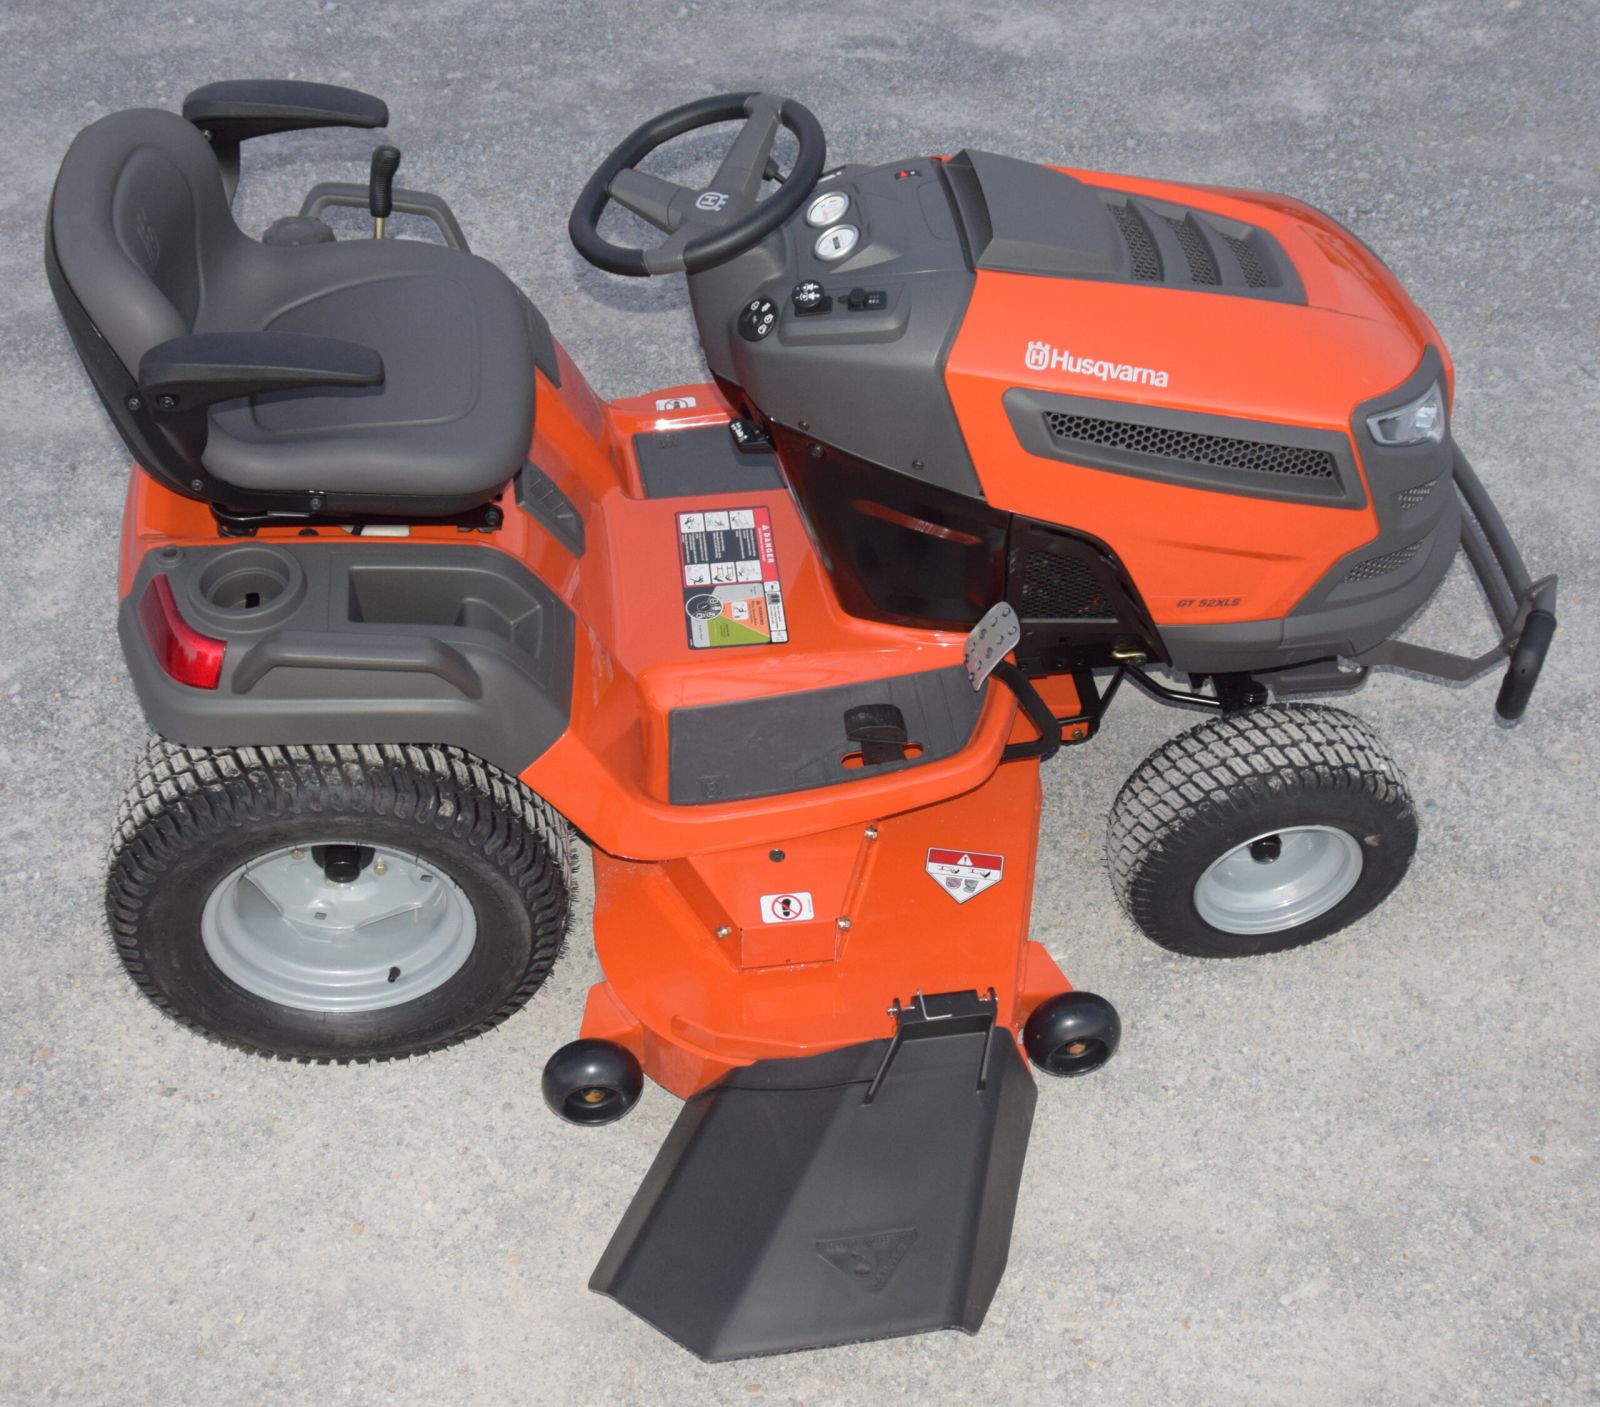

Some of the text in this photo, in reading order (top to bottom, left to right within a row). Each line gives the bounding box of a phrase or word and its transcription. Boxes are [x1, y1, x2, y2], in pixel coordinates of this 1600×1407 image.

[1050, 348, 1168, 388] Husqvarna
[763, 532, 775, 563] DANGER
[1177, 599, 1195, 608] GT
